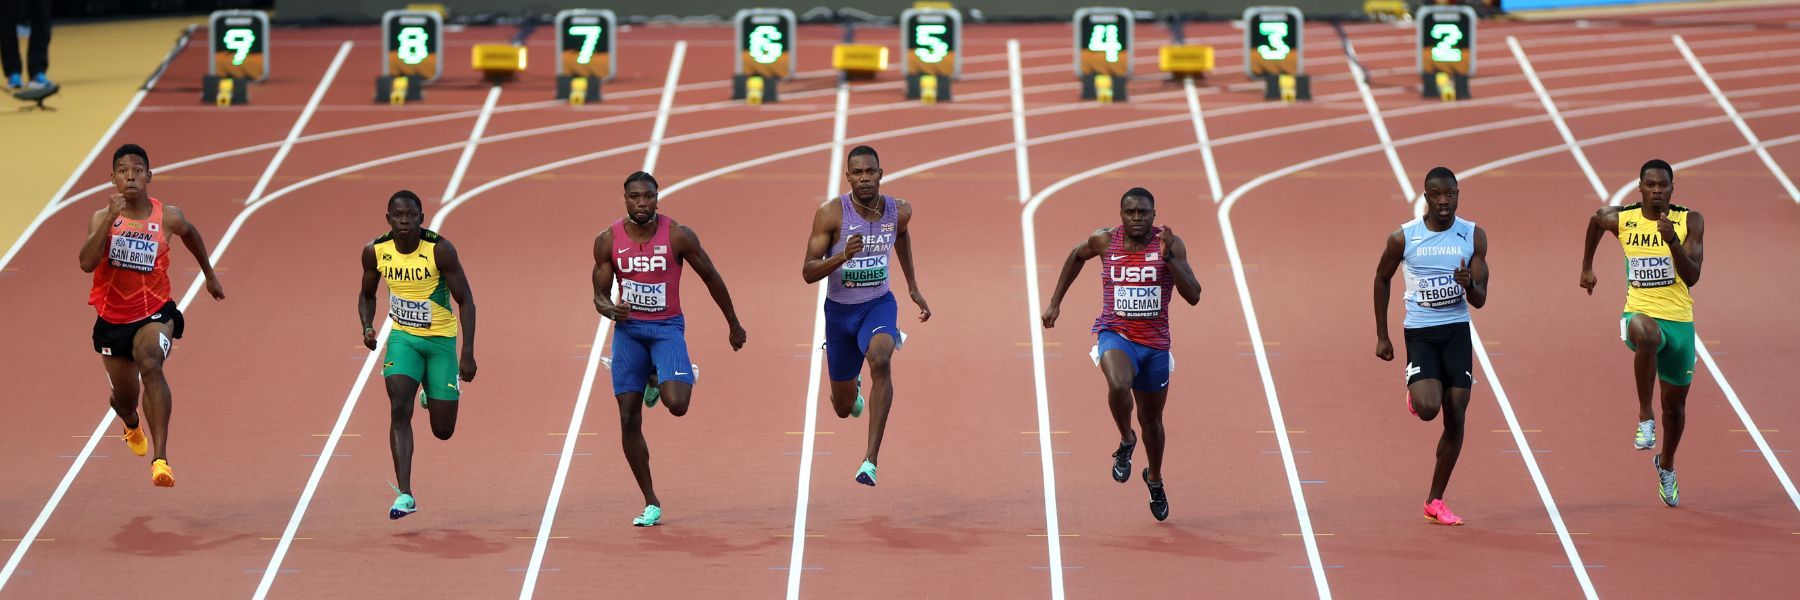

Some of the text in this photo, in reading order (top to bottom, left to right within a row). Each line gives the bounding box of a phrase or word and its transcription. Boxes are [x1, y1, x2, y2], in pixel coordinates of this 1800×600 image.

[223, 29, 255, 65] 9
[398, 27, 428, 64] 8
[569, 25, 602, 64] 7
[750, 25, 783, 63] 6
[915, 25, 948, 62] 5
[1088, 24, 1122, 62] 4
[1258, 22, 1290, 60] 3
[1431, 23, 1463, 62] 2
[120, 230, 153, 241] JAPAN
[126, 238, 155, 252] TDK
[1416, 246, 1462, 256] BOTSWANA
[111, 248, 154, 264] SANI BROWN
[856, 255, 884, 268] TDK
[1638, 257, 1670, 267] TDK
[617, 256, 667, 273] USA
[384, 266, 431, 280] JAMAICA
[845, 268, 884, 280] HUGHES
[1110, 266, 1157, 282] USA
[1634, 269, 1668, 279] FORDE
[632, 282, 663, 294] TDK
[1126, 287, 1158, 297] TDK
[1420, 285, 1460, 300] TEBOGO
[398, 298, 429, 311] TDK
[627, 291, 658, 305] LYLES
[1116, 299, 1159, 310] COLEMAN
[392, 304, 429, 321] SEVILLE
